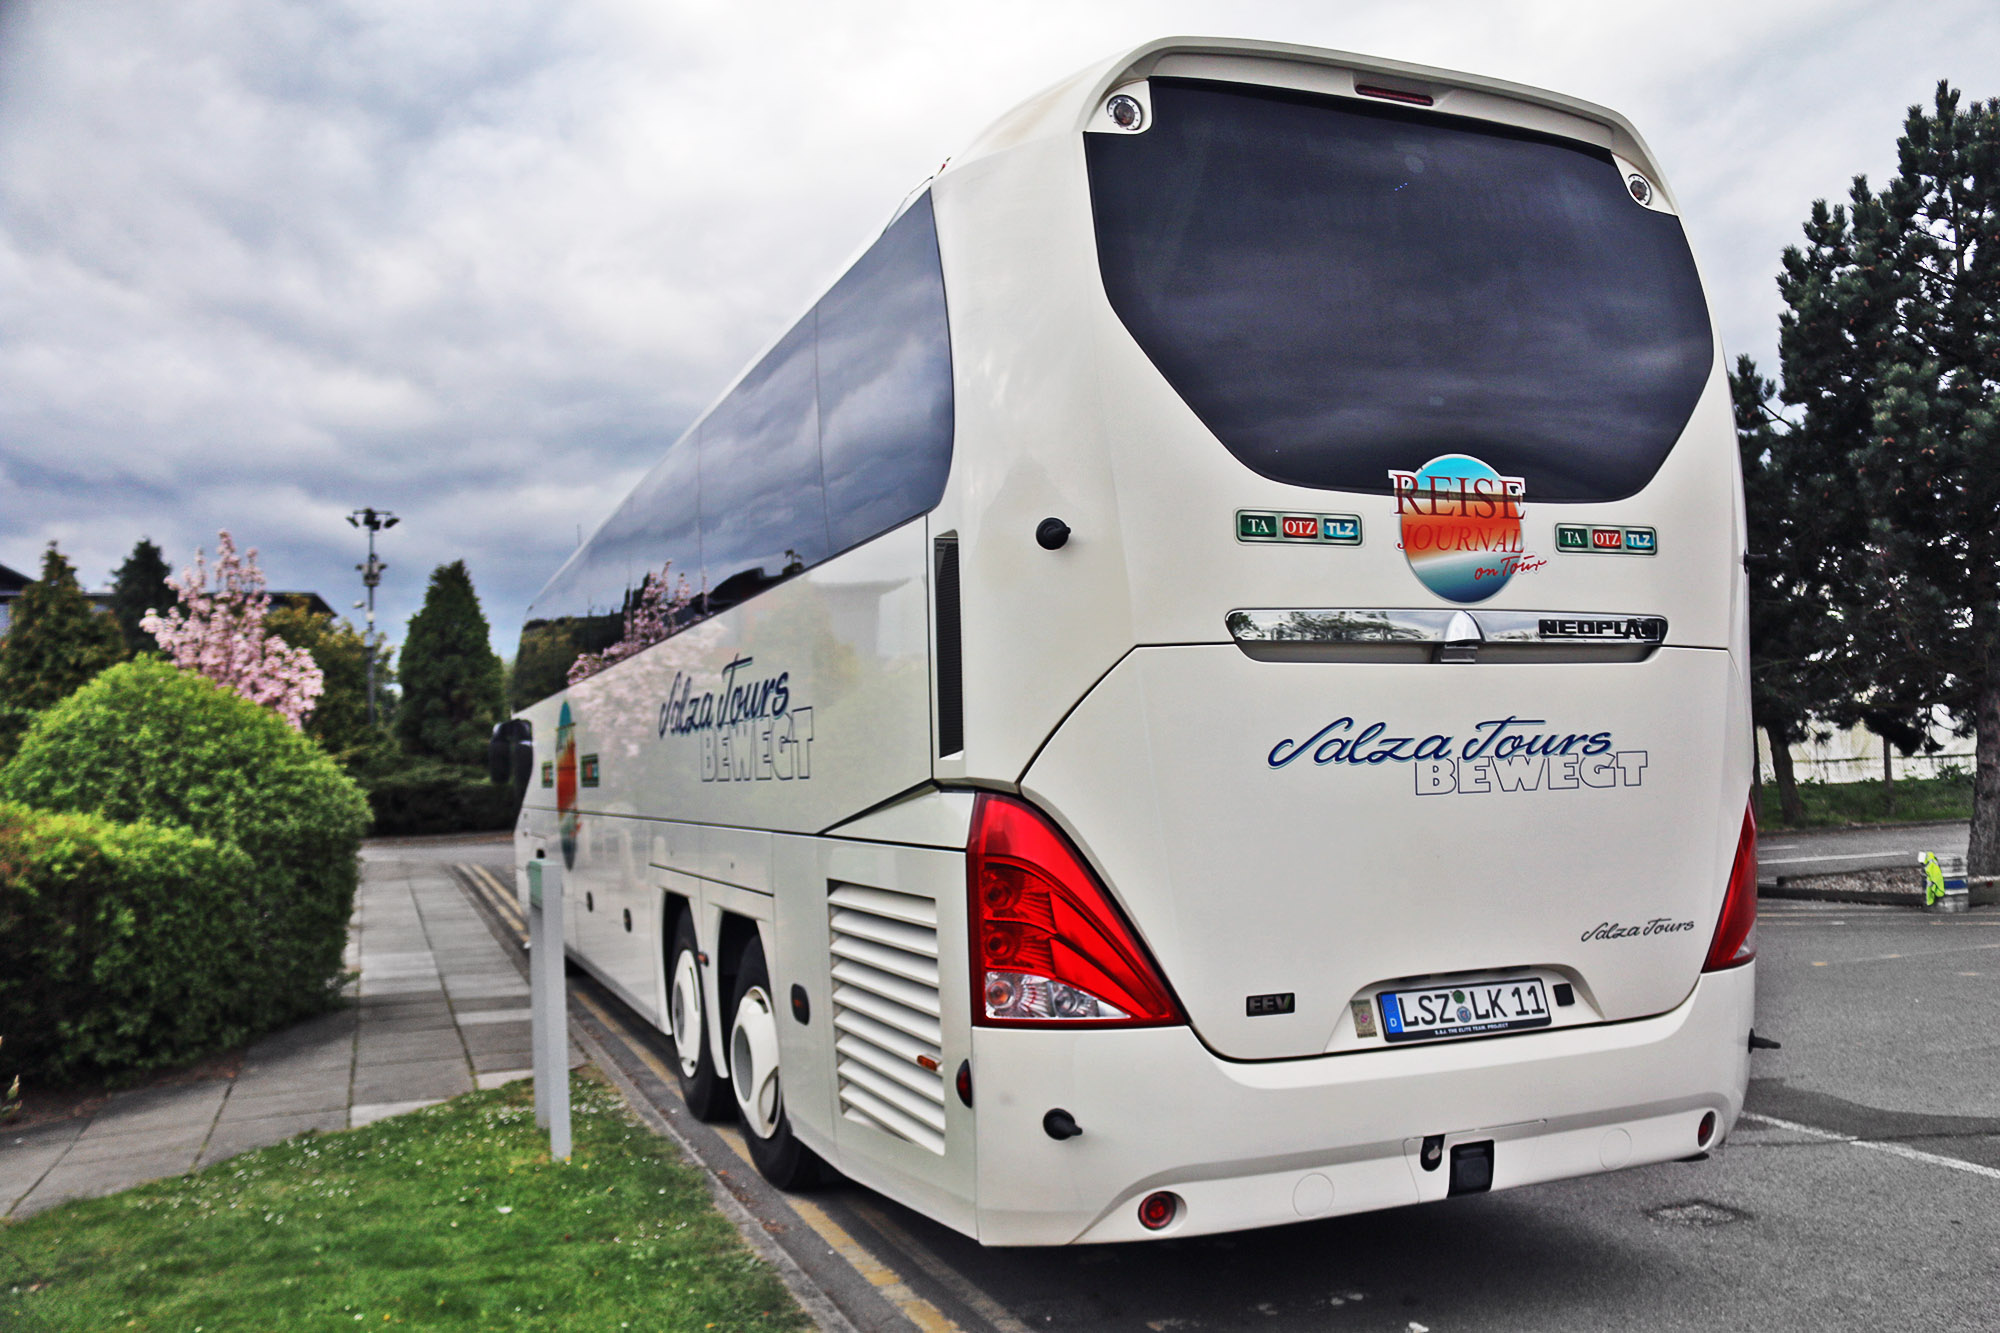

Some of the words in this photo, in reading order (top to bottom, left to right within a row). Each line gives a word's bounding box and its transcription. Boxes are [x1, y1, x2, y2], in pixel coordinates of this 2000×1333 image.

[1392, 474, 1526, 520] REISE
[1248, 518, 1269, 533] TA
[1284, 520, 1316, 535] OTZ
[1326, 522, 1355, 536] TLZ
[1396, 524, 1525, 554] JOURNAL
[1564, 531, 1583, 545] TA
[1594, 532, 1620, 546] OTZ
[1627, 533, 1651, 547] TLZ
[1474, 566, 1498, 581] on
[1500, 555, 1548, 578] Tour
[1538, 618, 1660, 640] NEOPLAN
[659, 671, 714, 740] Salza
[716, 653, 790, 729] Tours
[701, 706, 814, 782] BEWEGT
[1267, 716, 1456, 770] Salza
[1461, 715, 1613, 762] Tours
[1414, 750, 1649, 796] BEWEGT
[1581, 921, 1641, 942] Salza
[1642, 917, 1695, 936] Tours
[1249, 994, 1293, 1012] EEV
[1398, 993, 1456, 1027] LSZ
[1470, 988, 1508, 1020] LK
[1511, 985, 1546, 1016] 11
[1390, 1017, 1398, 1028] D
